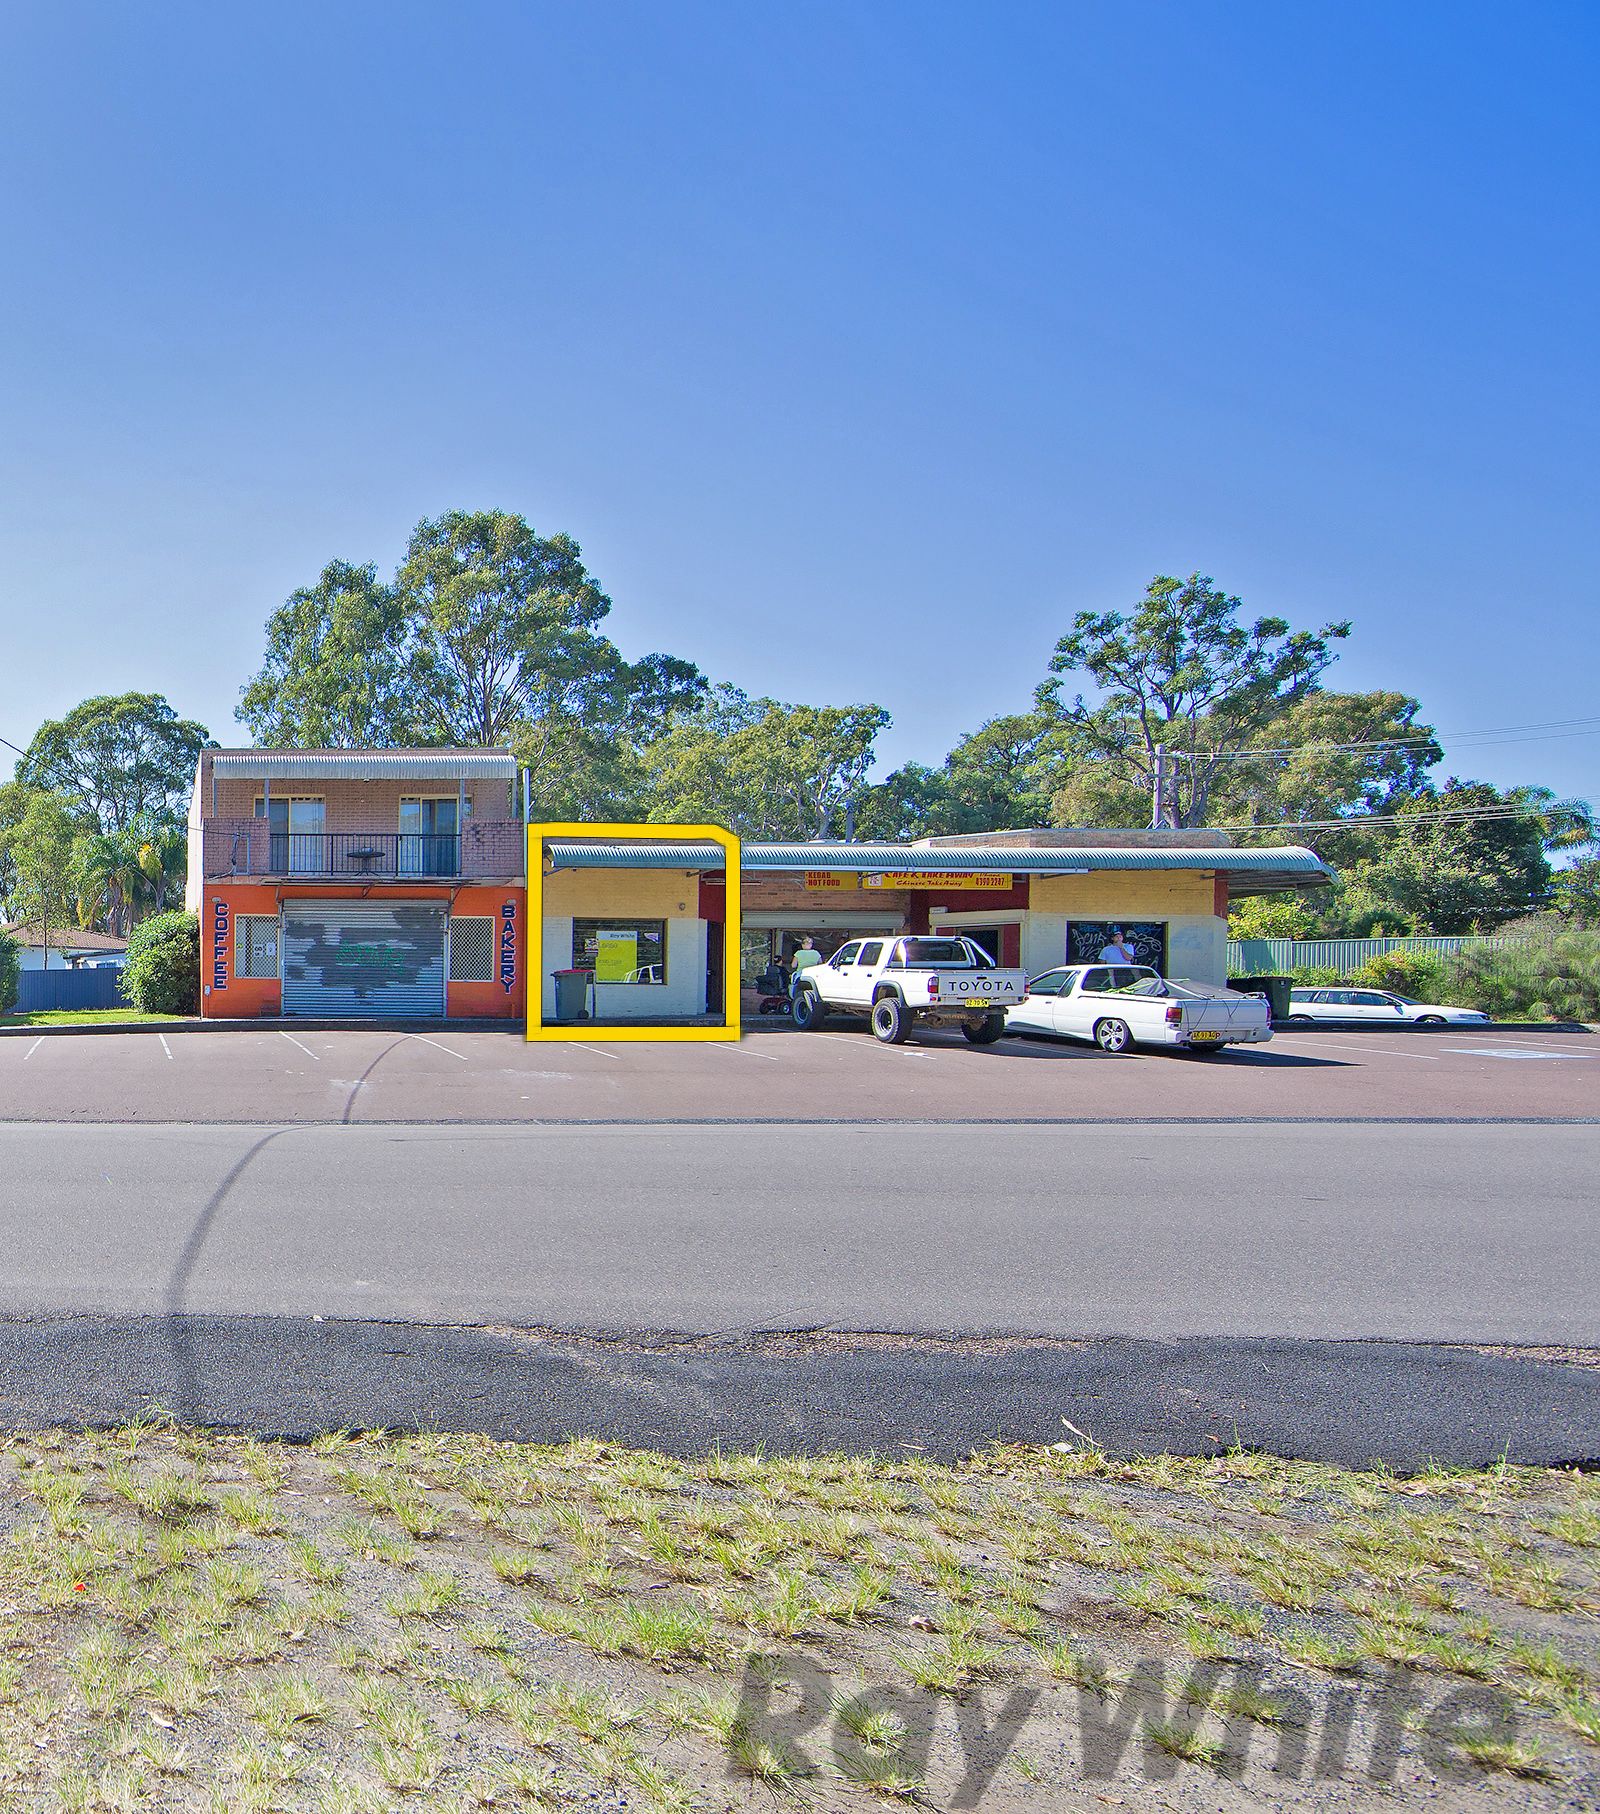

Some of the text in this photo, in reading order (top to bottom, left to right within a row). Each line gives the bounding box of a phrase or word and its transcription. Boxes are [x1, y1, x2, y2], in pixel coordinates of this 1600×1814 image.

[213, 903, 229, 991] COFFEE
[500, 905, 516, 994] BAKERY
[949, 981, 1013, 991] TOYOTA
